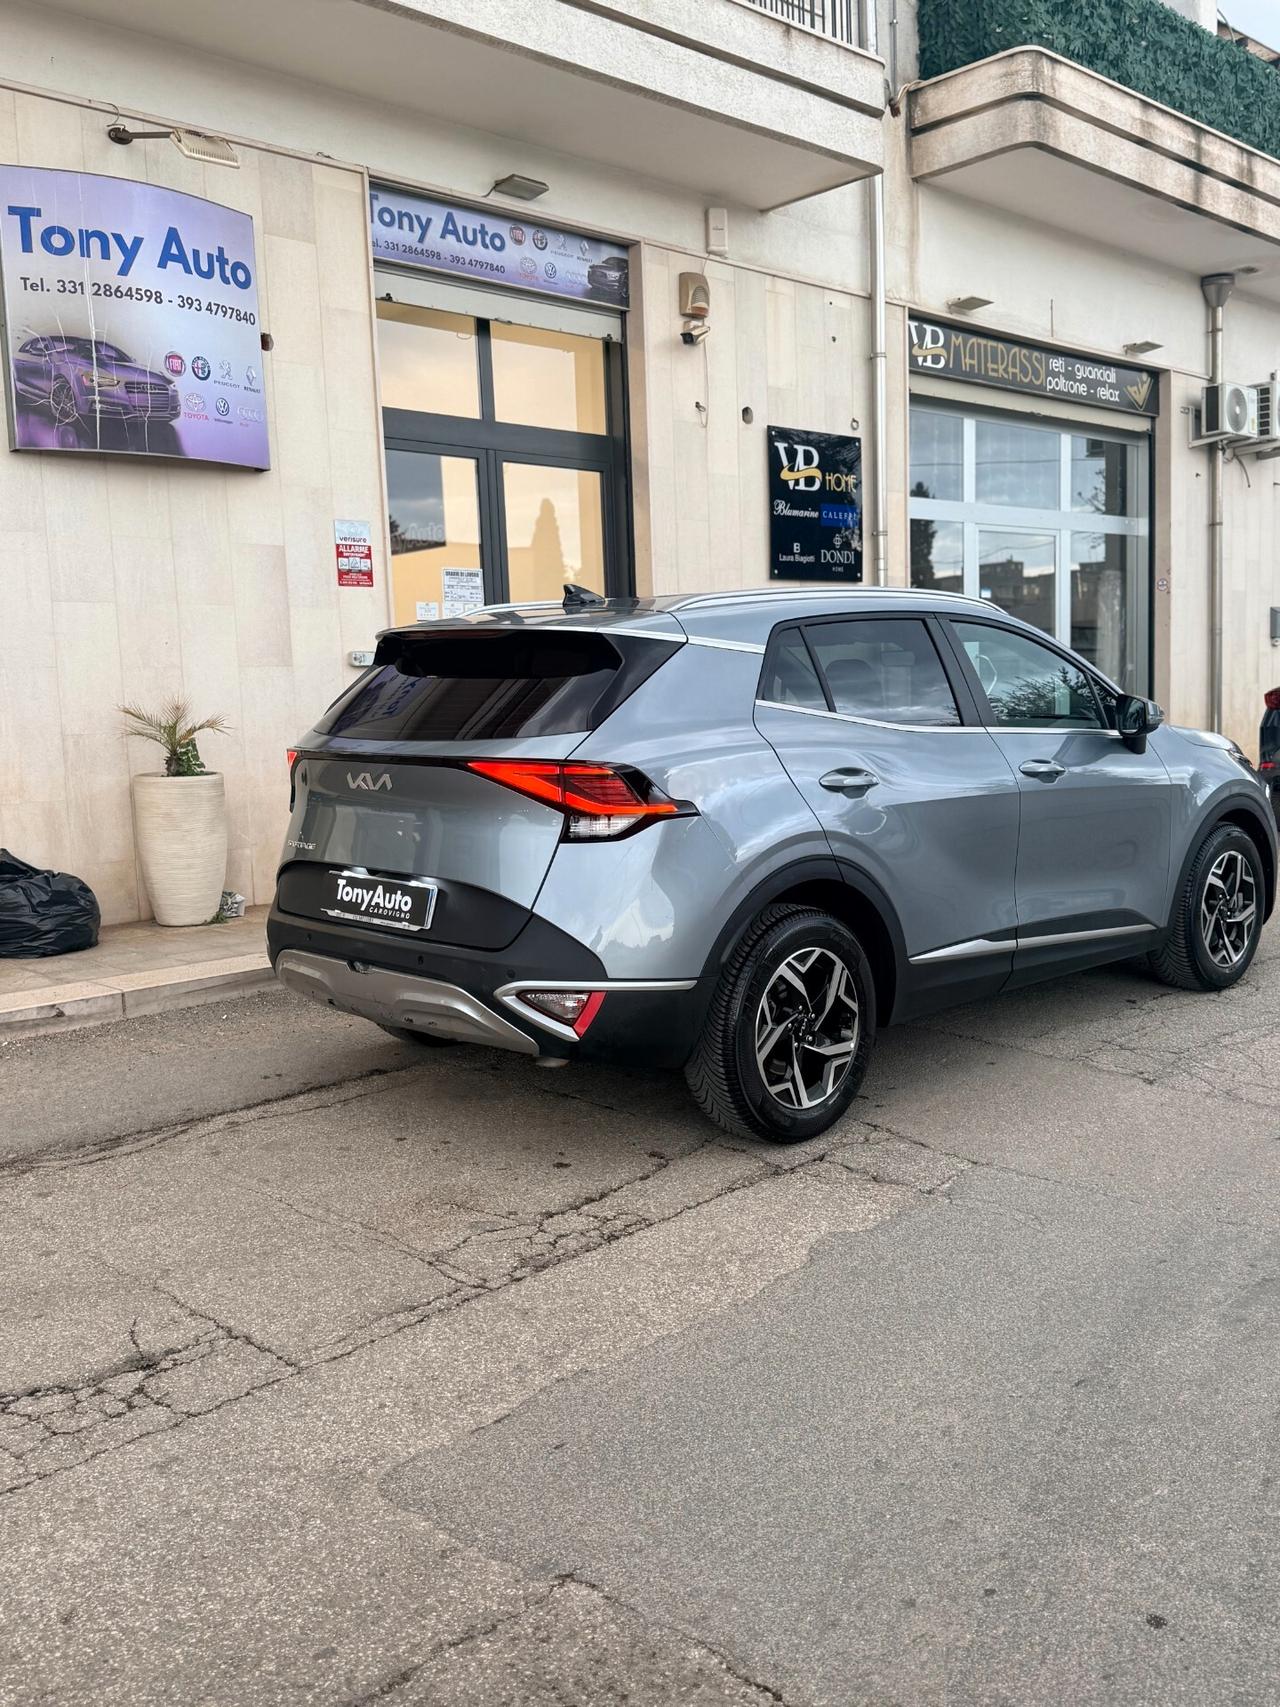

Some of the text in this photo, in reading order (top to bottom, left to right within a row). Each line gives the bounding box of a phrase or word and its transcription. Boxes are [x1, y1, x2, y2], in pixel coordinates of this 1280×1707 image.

[440, 211, 506, 252] Auto
[8, 205, 252, 289] Tony Auto
[384, 240, 399, 251] 331
[402, 244, 441, 260] 2864598
[449, 254, 466, 265] 393
[467, 258, 506, 274] 4797840
[20, 277, 50, 292] Tel.
[57, 279, 85, 295] 331
[92, 282, 163, 305] 2864598
[178, 295, 202, 312] 393
[205, 302, 256, 326] 4797840
[950, 333, 1046, 387] MATERASSI
[1049, 358, 1064, 372] reti
[1075, 363, 1116, 382] guanciali
[1046, 376, 1088, 397] poltrone
[1097, 386, 1120, 402] relax
[184, 412, 209, 421] TOYOTA
[774, 442, 857, 493] VB HOME
[773, 499, 819, 519] Blumarine
[779, 553, 794, 562] Laura
[820, 549, 855, 565] DONDI
[369, 906, 411, 919] CAROVIGNO
